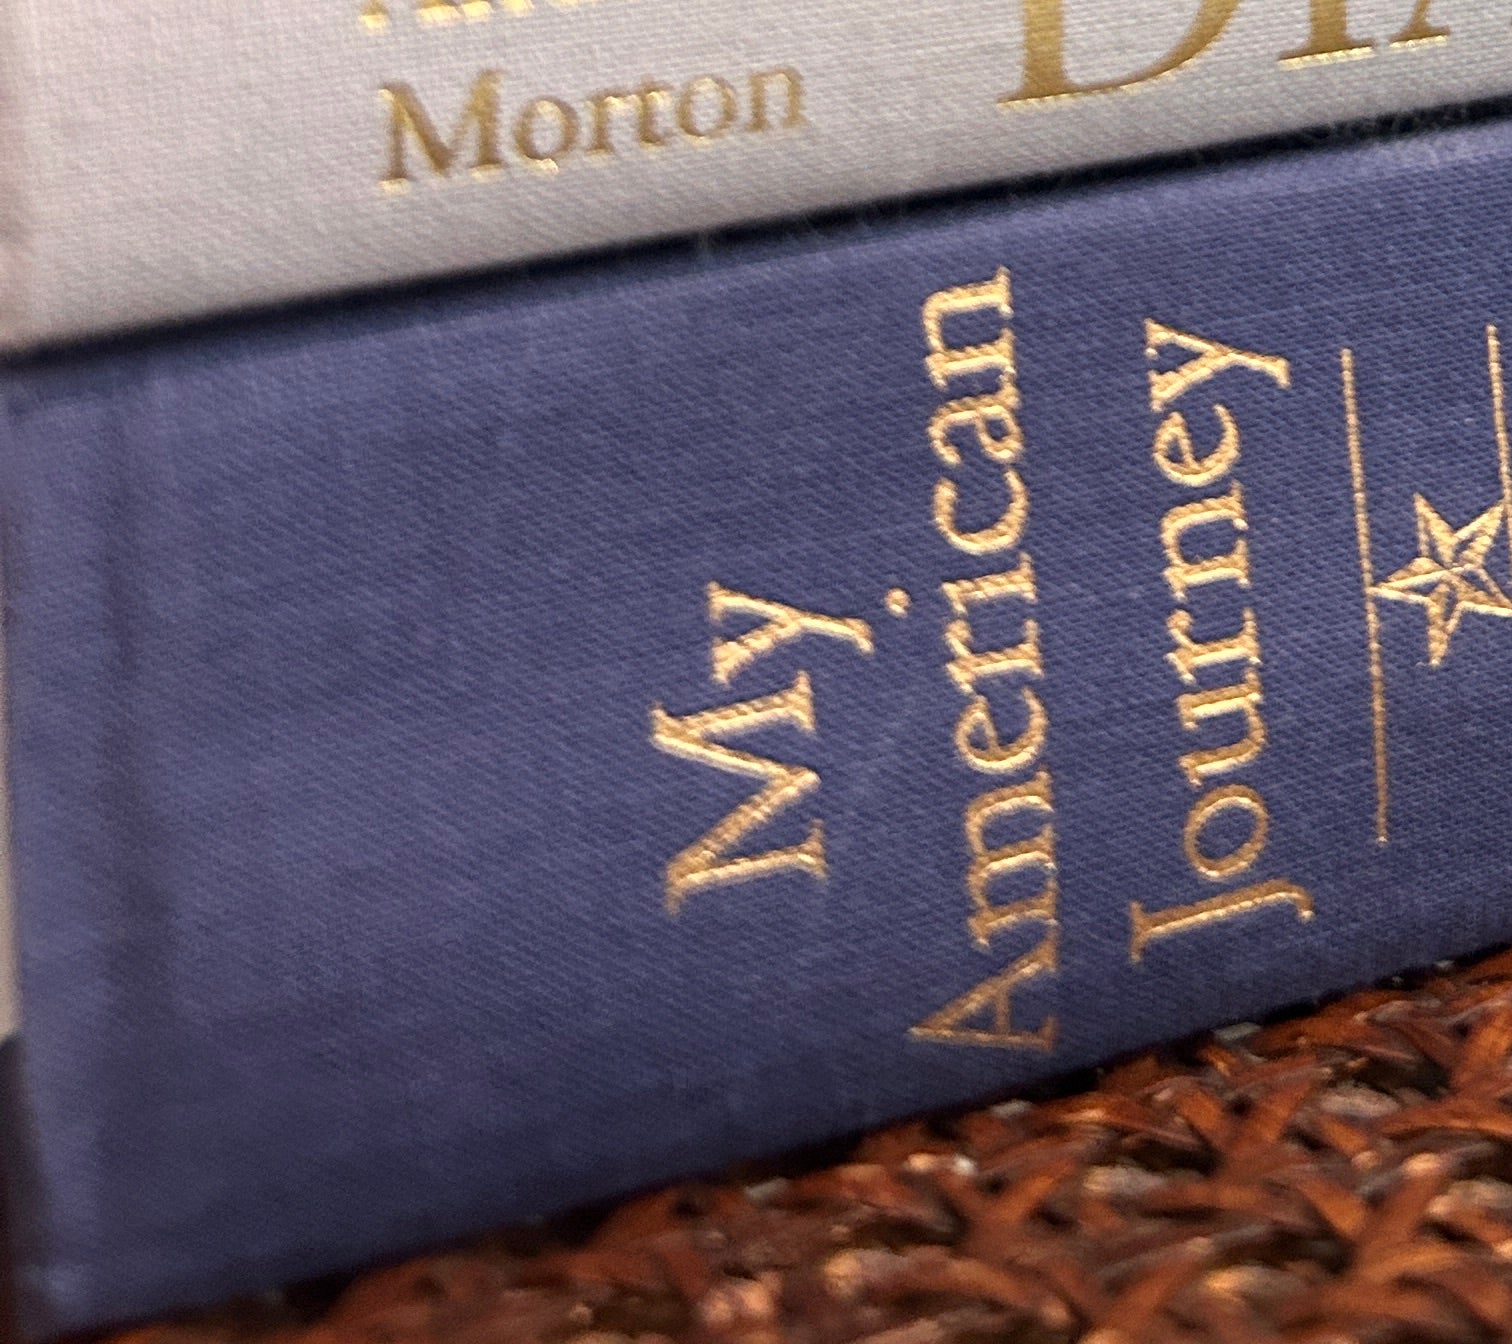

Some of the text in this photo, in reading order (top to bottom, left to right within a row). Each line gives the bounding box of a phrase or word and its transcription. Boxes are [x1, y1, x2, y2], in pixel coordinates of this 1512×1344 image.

[378, 62, 810, 193] Morton
[651, 580, 874, 916] My
[884, 266, 1062, 1055] American
[1130, 316, 1316, 964] Journey
